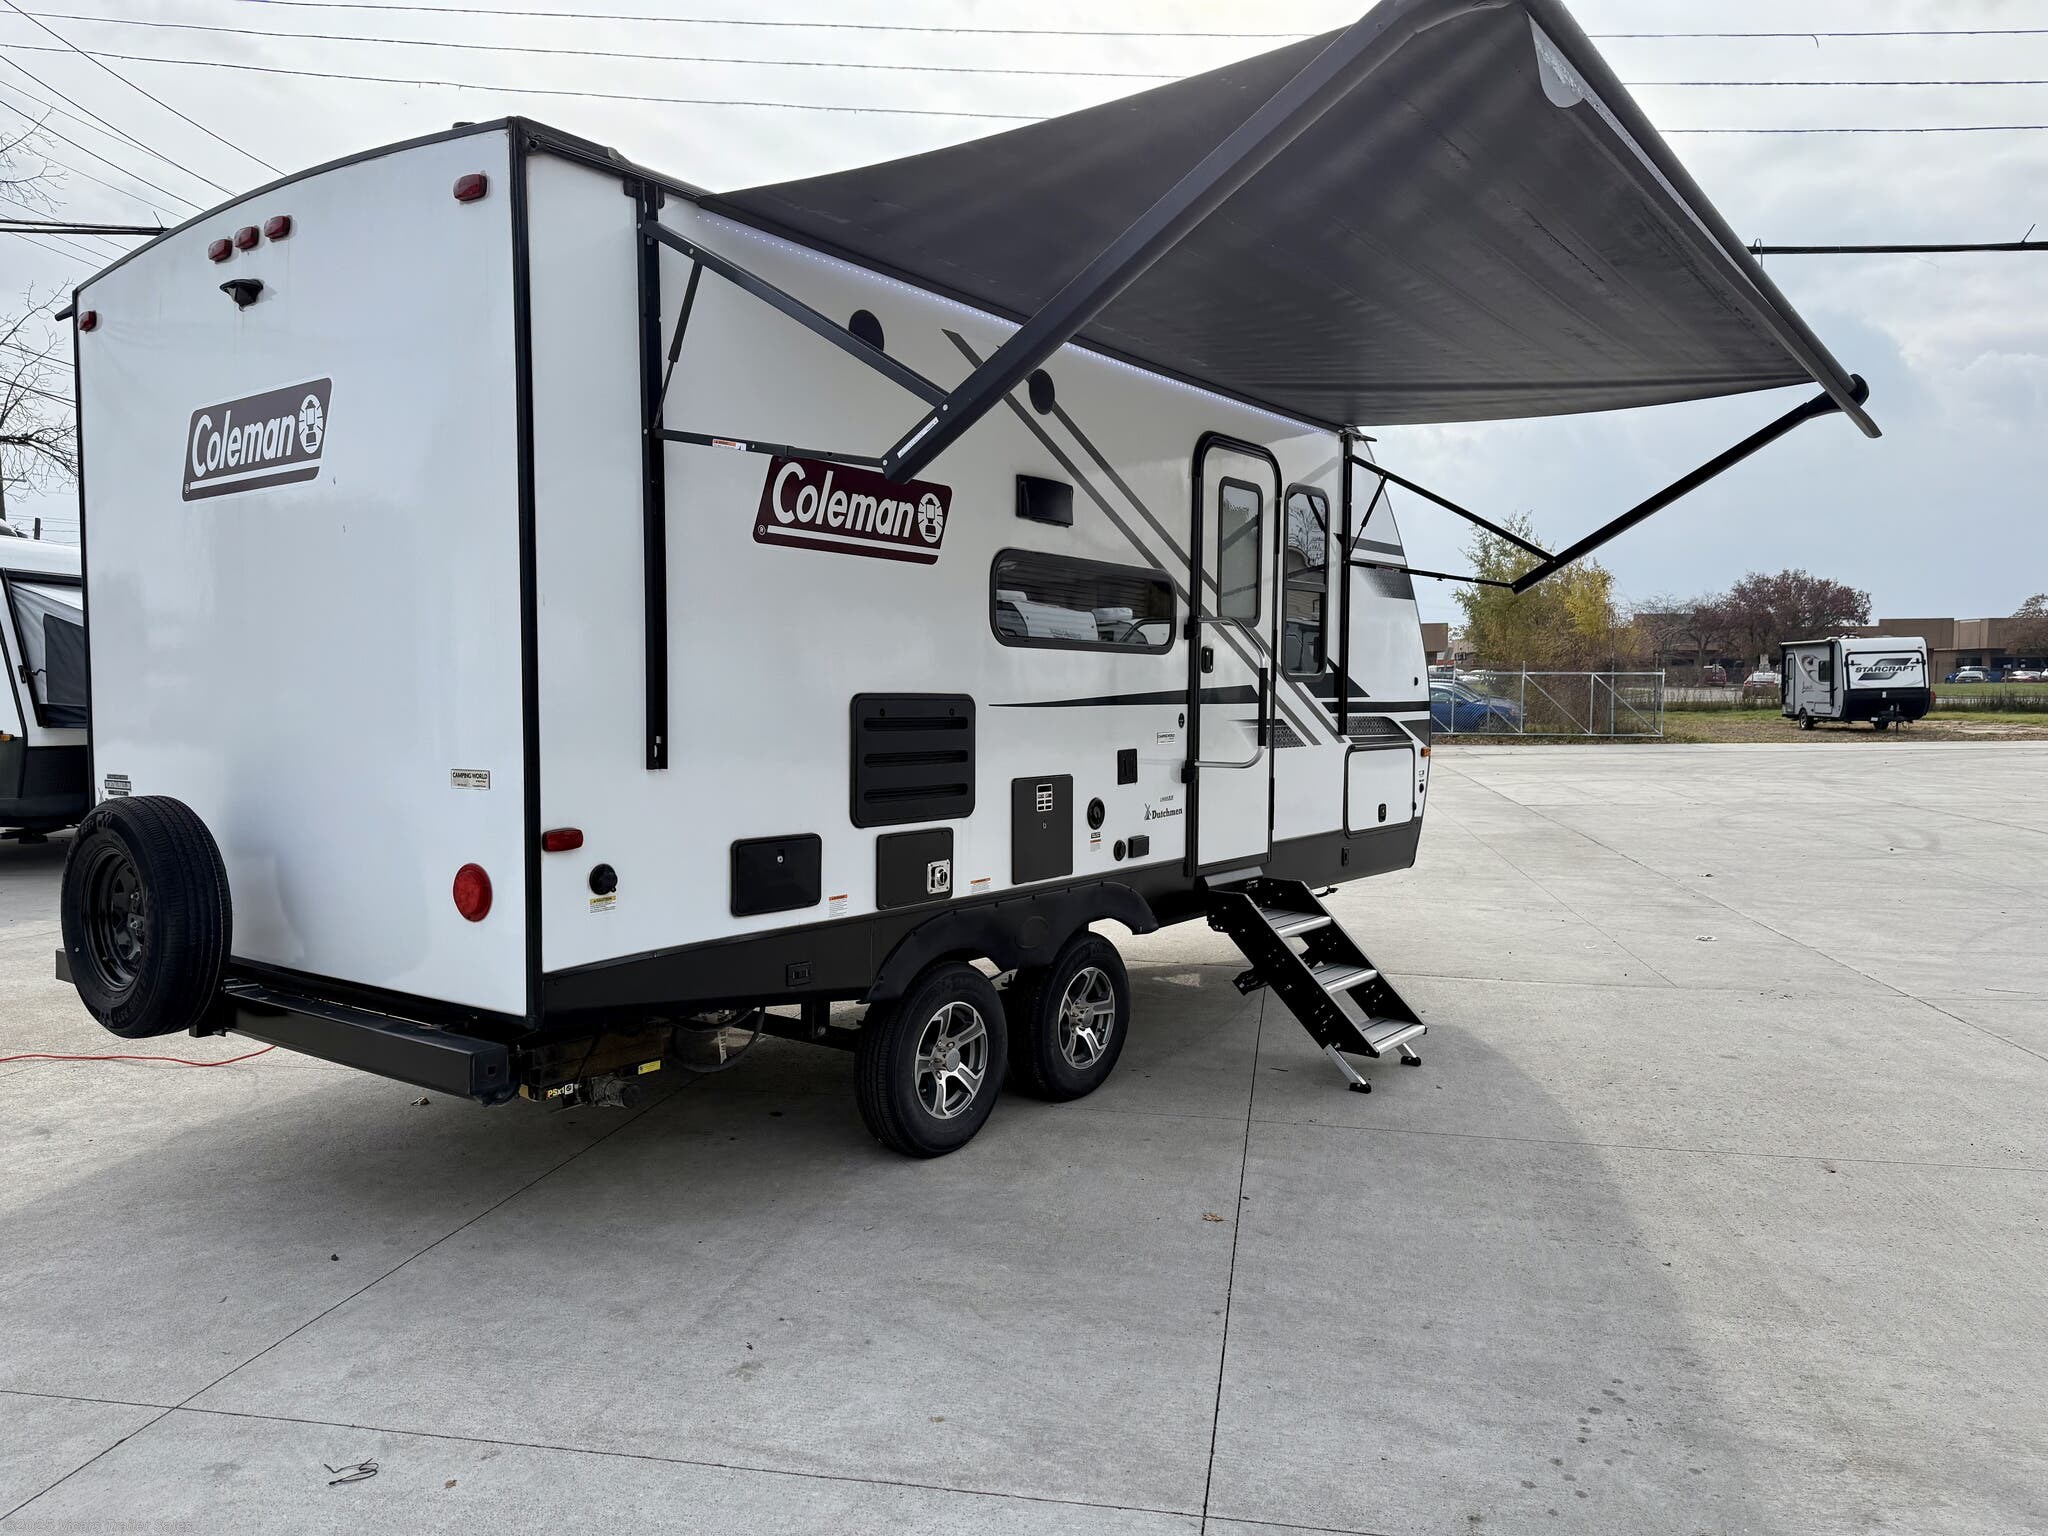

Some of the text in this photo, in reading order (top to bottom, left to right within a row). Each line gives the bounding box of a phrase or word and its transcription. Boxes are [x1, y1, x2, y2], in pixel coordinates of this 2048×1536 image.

[192, 410, 296, 477] Coleman
[772, 461, 915, 537] Coleman
[1855, 665, 1917, 673] STARCRAFT
[1152, 808, 1182, 819] Dutchmen
